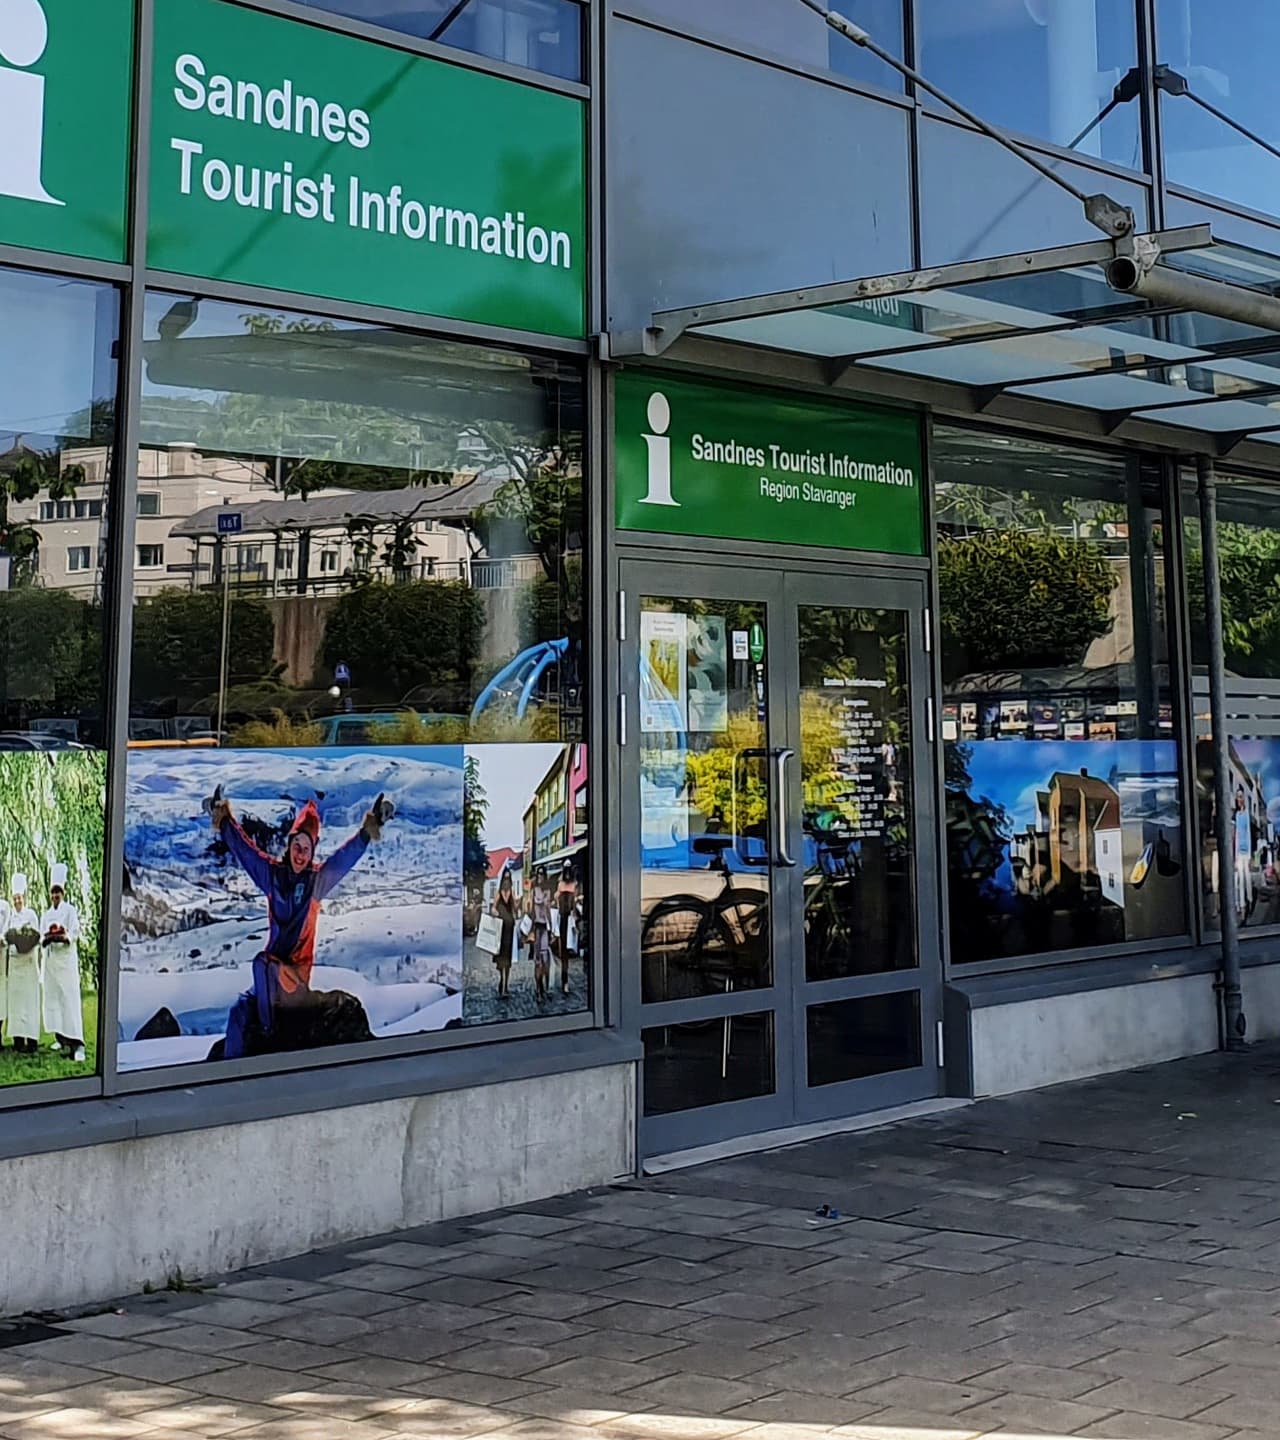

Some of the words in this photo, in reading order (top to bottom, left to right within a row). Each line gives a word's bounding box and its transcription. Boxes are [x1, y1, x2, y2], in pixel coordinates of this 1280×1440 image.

[173, 53, 371, 149] Sandnes
[170, 137, 336, 223] Tourist
[348, 175, 572, 269] Information
[691, 433, 765, 468] Sandnes
[769, 444, 827, 477] Tourist
[829, 453, 914, 488] Information
[760, 477, 800, 503] Region
[802, 482, 857, 510] Stavanger
